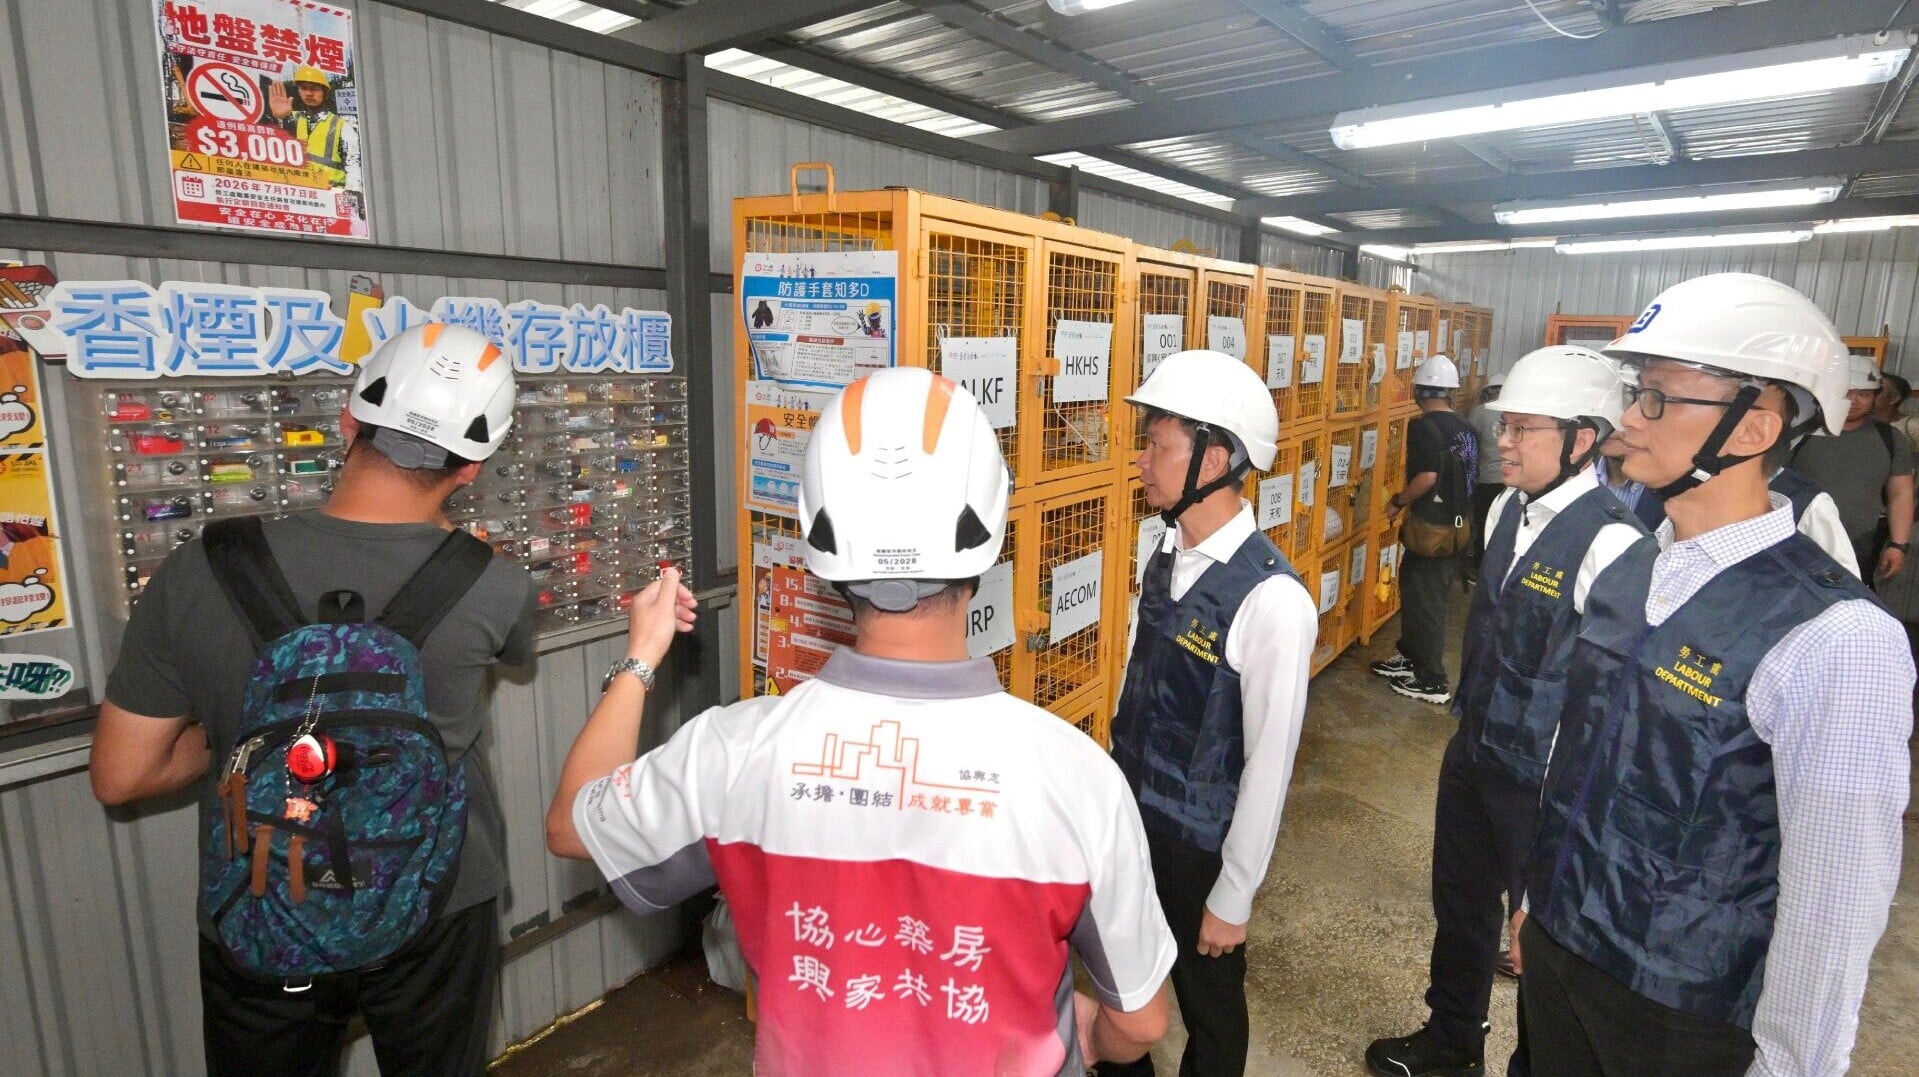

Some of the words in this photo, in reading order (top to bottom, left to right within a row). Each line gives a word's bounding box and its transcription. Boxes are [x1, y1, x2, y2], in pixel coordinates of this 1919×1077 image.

[163, 1, 347, 75] 地盤禁煙
[198, 126, 303, 166] $3,000
[215, 178, 249, 190] 2026
[252, 182, 261, 192] 年
[219, 207, 276, 220] 安全在心
[778, 281, 869, 298] 防護手套知多D
[1159, 334, 1177, 348] 001
[1222, 336, 1235, 349] 004
[1065, 355, 1099, 376] HKHS
[961, 377, 1003, 405] LKF
[1531, 572, 1559, 588] LABOUR
[1056, 580, 1097, 615] AECOM
[965, 604, 994, 639] RP
[777, 635, 786, 648] 3
[1175, 635, 1220, 664] DEPARTMENT
[1187, 630, 1212, 650] LABOUR
[0, 661, 72, 695] 呀?
[1654, 666, 1723, 708] DEPARTMENT
[1674, 661, 1712, 688] LABOUR
[908, 793, 998, 819] 成就專業
[785, 900, 992, 972] 協心築房
[788, 955, 989, 1025] 興家共協
